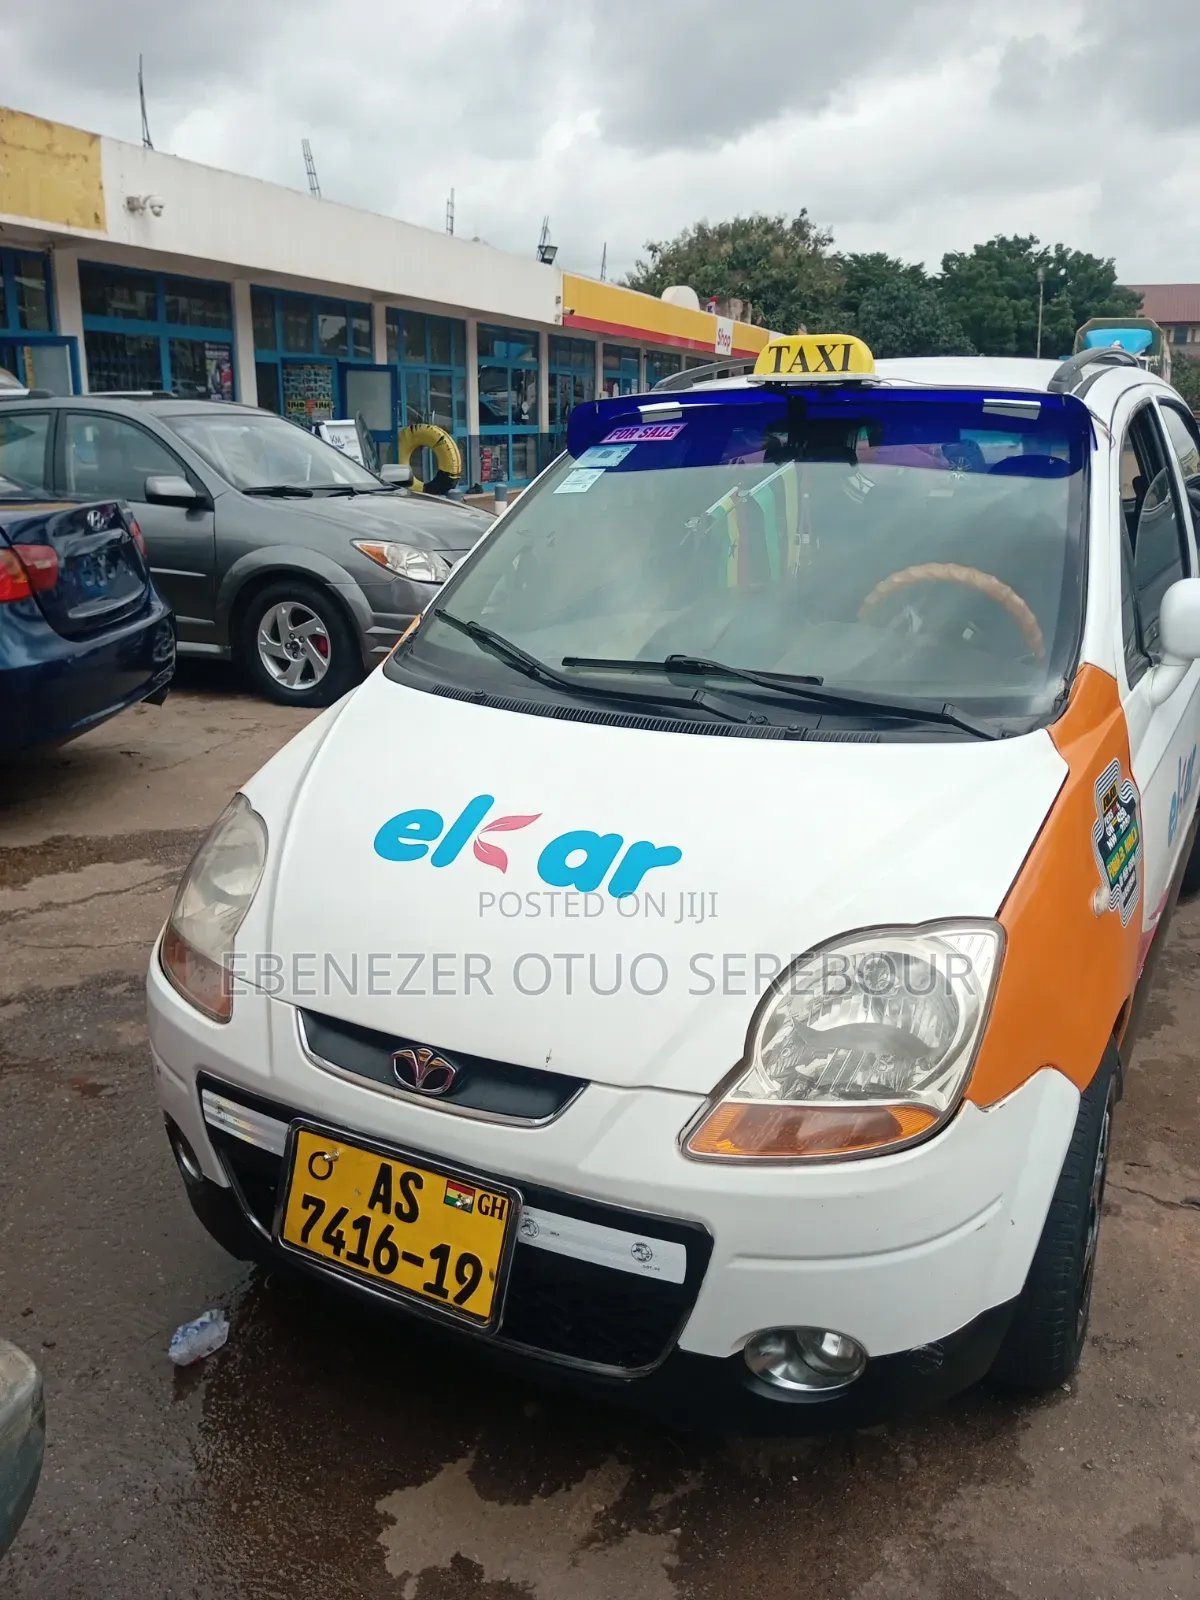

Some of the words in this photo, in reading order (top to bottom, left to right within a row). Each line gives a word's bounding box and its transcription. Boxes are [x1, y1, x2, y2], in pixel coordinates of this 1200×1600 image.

[717, 327, 731, 352] Shop
[768, 343, 854, 374] TAXI
[607, 428, 639, 440] FOR
[638, 425, 680, 438] SALE
[367, 1162, 424, 1224] AS
[477, 1193, 507, 1221] GH
[300, 1193, 483, 1306] 7416-19
